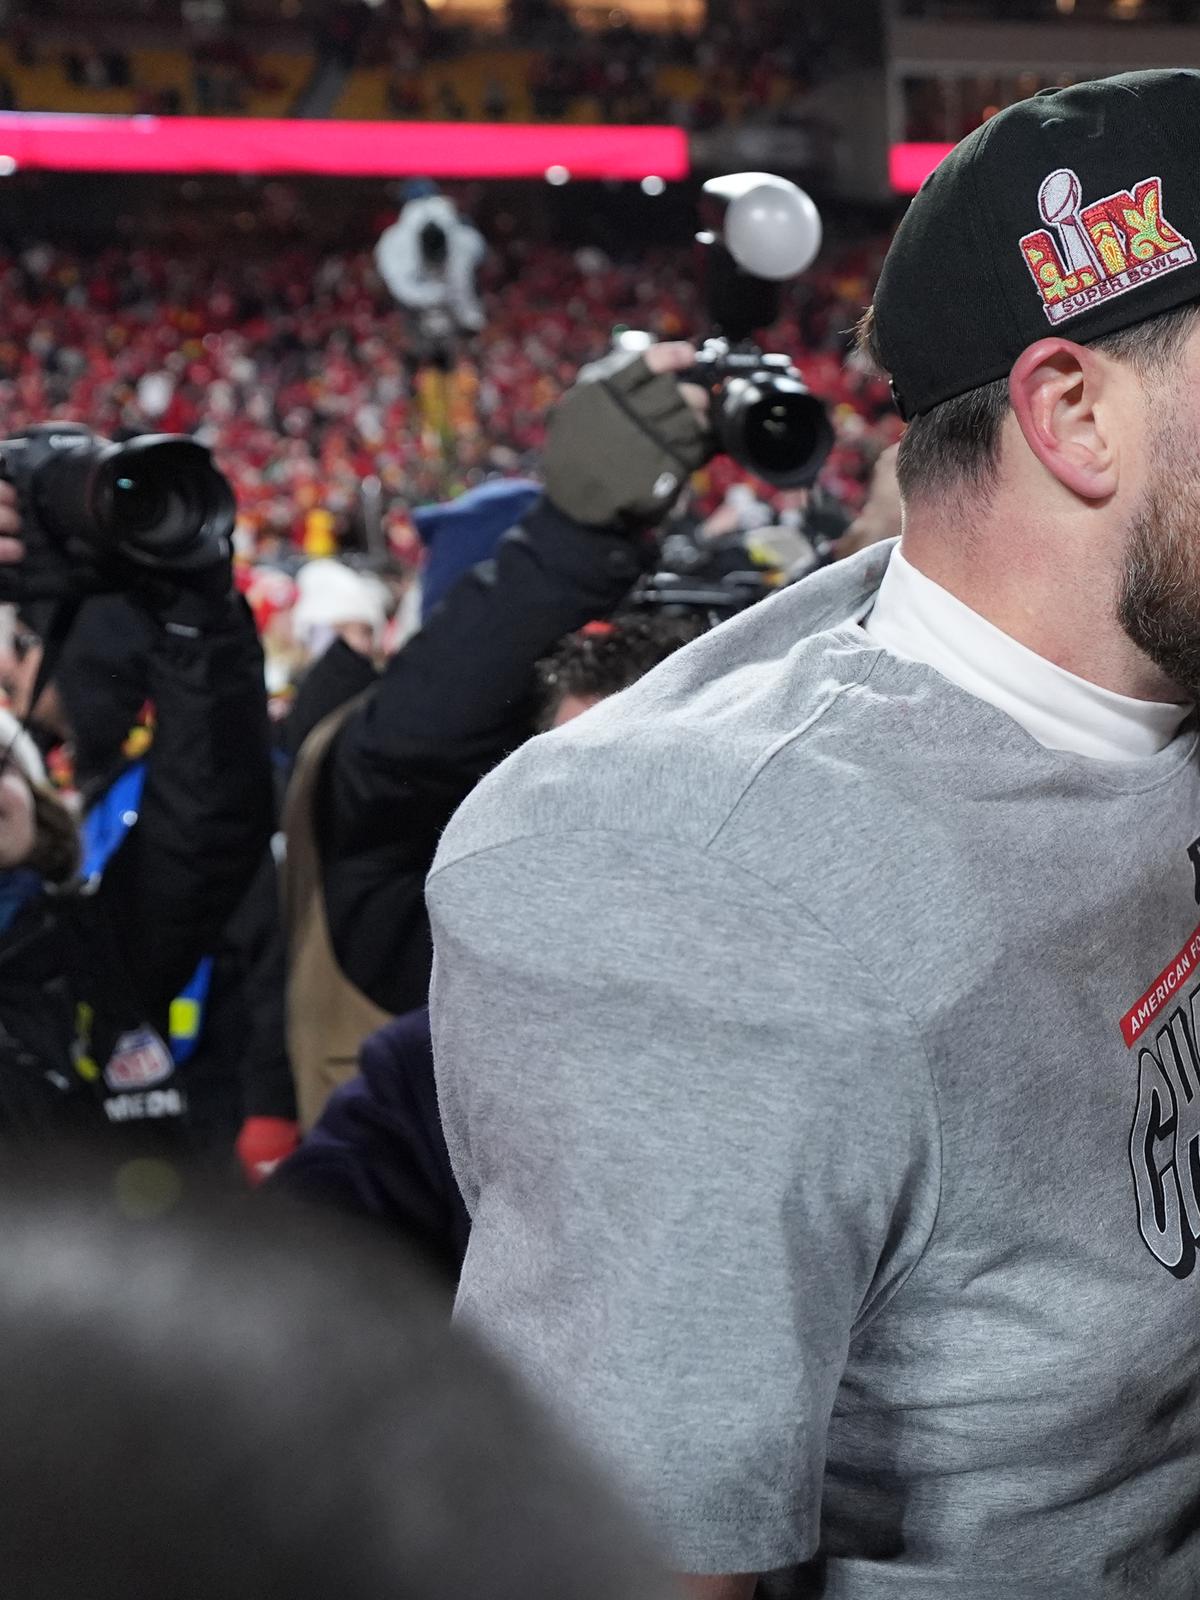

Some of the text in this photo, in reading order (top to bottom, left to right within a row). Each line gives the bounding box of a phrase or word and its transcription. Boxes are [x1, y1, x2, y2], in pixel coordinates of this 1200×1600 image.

[1021, 178, 1184, 305] LIX
[1062, 255, 1179, 313] SUPER BOWL
[1131, 957, 1191, 1035] AMERICAN
